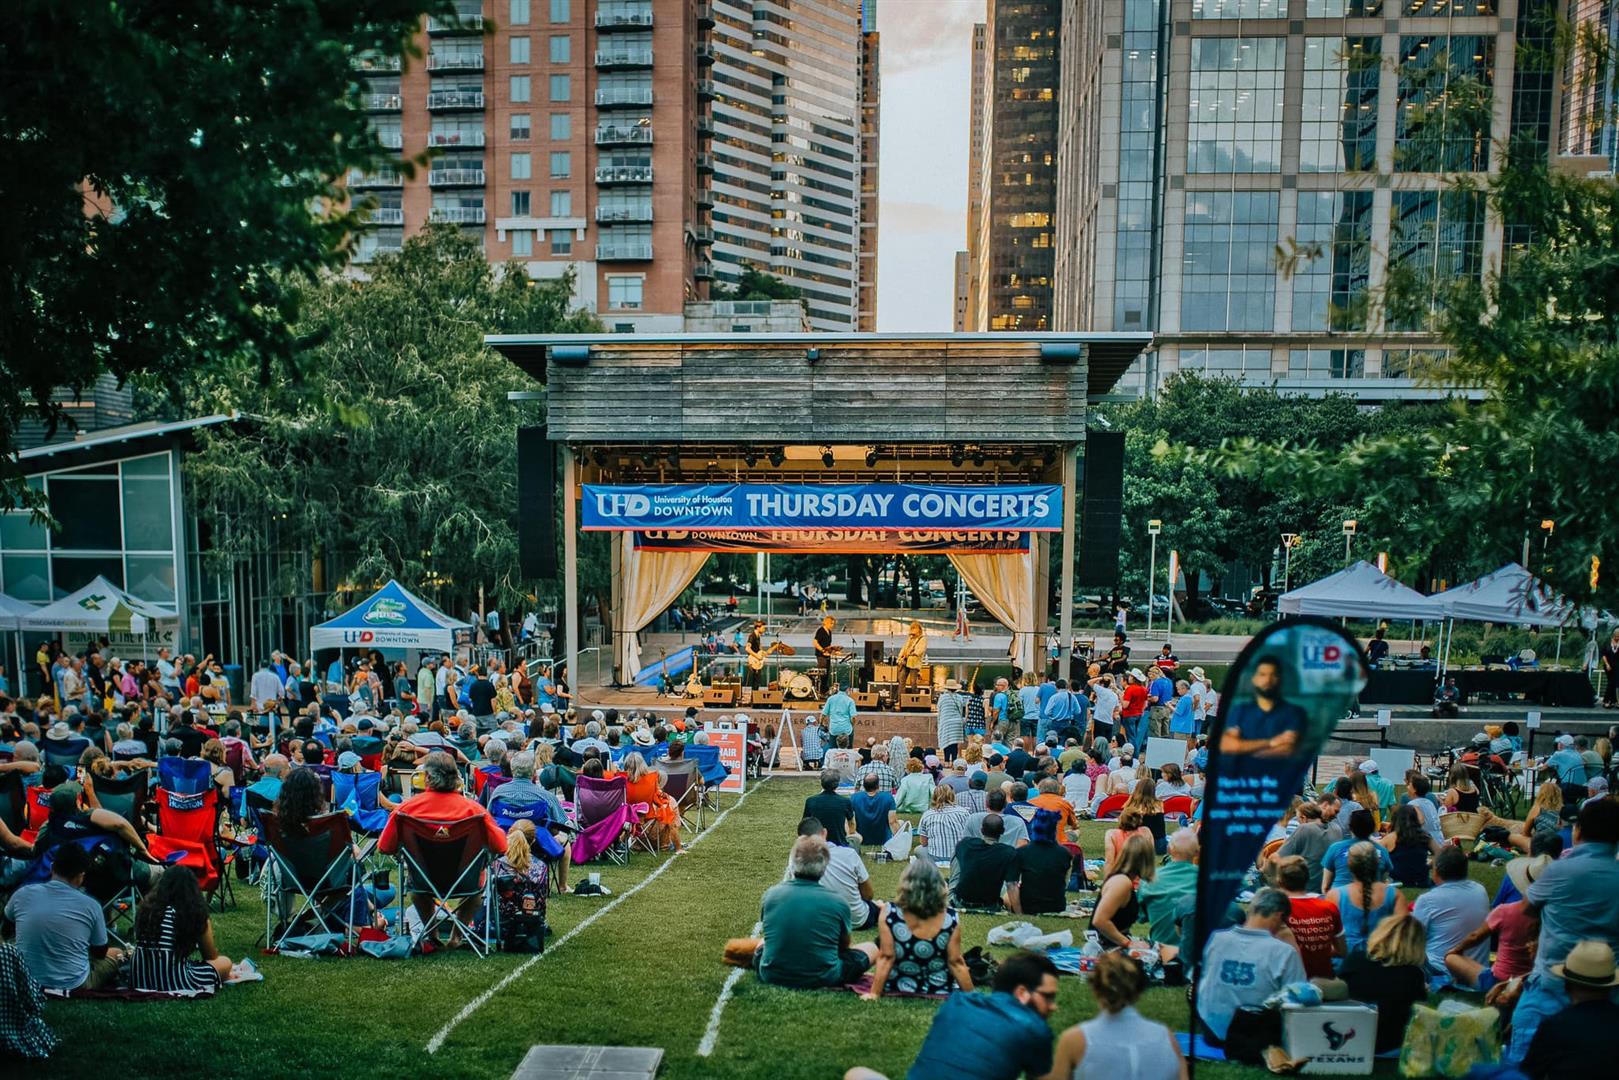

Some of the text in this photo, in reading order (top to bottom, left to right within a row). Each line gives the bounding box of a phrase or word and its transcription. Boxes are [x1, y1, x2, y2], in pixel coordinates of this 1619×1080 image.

[595, 493, 651, 517] UHD
[654, 495, 733, 505] University of Houston
[746, 493, 1050, 518] THURSDAY CONCERTS
[654, 505, 733, 516] DOWNTOWN
[344, 630, 374, 643] UHD
